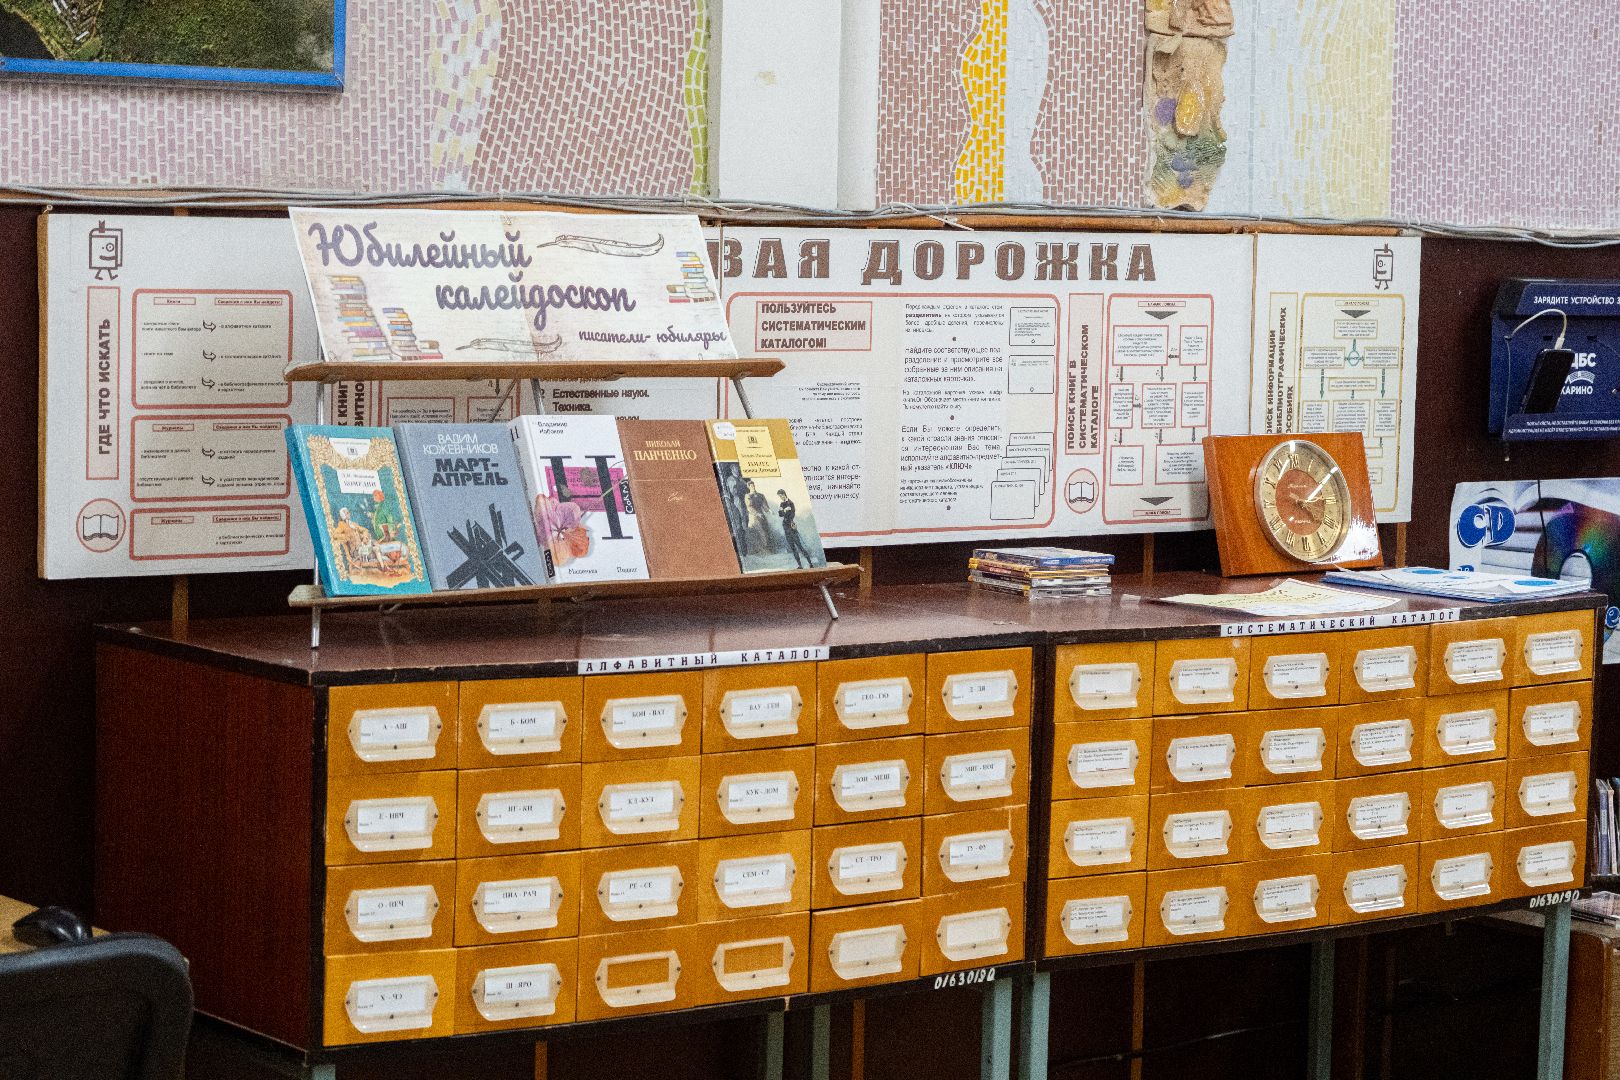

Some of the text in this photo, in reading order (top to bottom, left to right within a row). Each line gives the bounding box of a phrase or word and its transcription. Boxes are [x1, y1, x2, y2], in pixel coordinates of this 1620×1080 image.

[307, 221, 532, 268] Юбилейный
[861, 239, 1156, 286] ДОРОЖКА
[435, 271, 636, 331] калейдоскоп
[761, 302, 837, 314] ПОЛЬЗУЙТЕСЬ
[1534, 295, 1614, 305] ЗАРЯДИТЕ УСТРОЙСТВО
[579, 325, 727, 350] писатели- юбиляры
[761, 320, 866, 332] СИСТЕМАТИЧЕСКИМ
[761, 337, 827, 349] КАТАЛОГОМ!
[1268, 330, 1276, 404] ИНФОРМАЦИИ
[98, 319, 112, 455] ГДЕ ЧТО ИСКАТЬ
[552, 388, 620, 399] Естественные
[1068, 372, 1076, 403] КНИГ
[1078, 324, 1088, 449] СИСТЕМАТИЧЕСКОМ
[552, 402, 592, 412] Техника.
[1090, 386, 1099, 448] КАТАЛОГЕ
[438, 434, 478, 444] ВАДИМ
[1068, 407, 1076, 449] ПОИСК
[423, 444, 498, 455] КОЖЕВНИКОВ
[634, 450, 697, 461] ПАНЧЕНКО
[435, 458, 499, 472] МАРТ-
[432, 472, 508, 486] АПРЕЛЬ
[1457, 504, 1516, 548] CD
[1226, 610, 1455, 635] СИСТЕМАТИЧЕСКИЙ КАТАЛОГ
[586, 648, 821, 672] АЛФАВИТНЫЙ КАТАЛОГ
